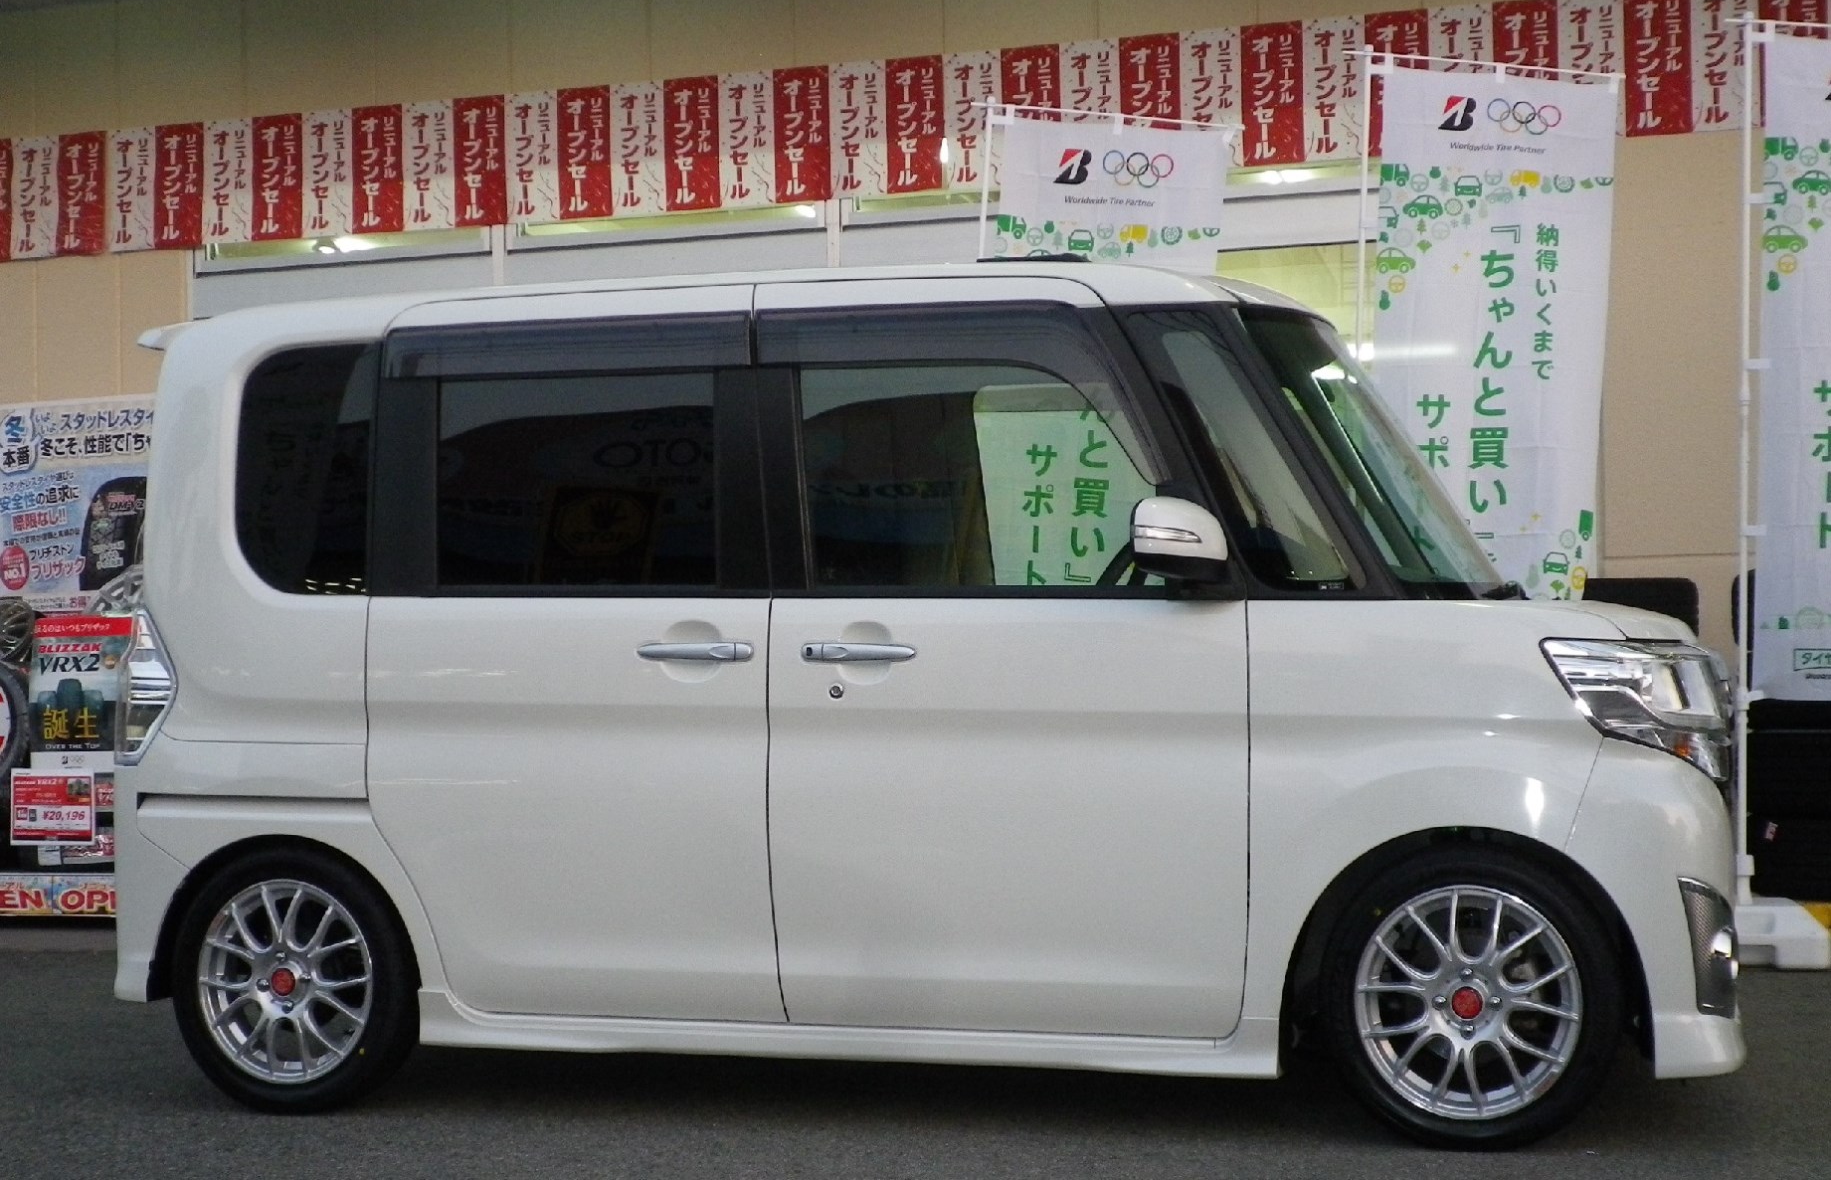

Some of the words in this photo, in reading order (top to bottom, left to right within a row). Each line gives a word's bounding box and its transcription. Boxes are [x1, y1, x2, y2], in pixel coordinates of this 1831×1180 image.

[1279, 34, 1294, 104] リニューアル
[1341, 29, 1357, 98] リニューアル
[1636, 1, 1662, 128] オープンセール
[1665, 0, 1682, 71] リニューアル
[864, 73, 878, 138] リニューアル
[921, 67, 936, 134] リニューアル
[1156, 45, 1172, 114] リニューアル
[1217, 40, 1232, 109] リニューアル
[1252, 36, 1276, 160] オープンセール
[1314, 30, 1338, 154] オープンセール
[434, 112, 447, 174] リニューアル
[485, 107, 498, 170] リニューアル
[537, 102, 550, 165] リニューアル
[590, 98, 604, 161] リニューアル
[643, 93, 657, 156] リニューアル
[697, 88, 711, 153] リニューアル
[728, 84, 750, 199] オープンセール
[753, 83, 766, 148] リニューアル
[783, 80, 805, 196] オープンセール
[808, 78, 822, 143] リニューアル
[839, 74, 861, 190] オープンセール
[896, 69, 918, 186] オープンセール
[954, 64, 977, 182] オープンセール
[39, 147, 52, 207] リニューアル
[84, 142, 99, 203] リニューアル
[136, 138, 149, 196] リニューアル
[185, 134, 197, 194] リニューアル
[234, 130, 246, 189] リニューアル
[260, 126, 281, 233] オープンセール
[282, 125, 296, 186] リニューアル
[311, 122, 329, 230] オープンセール
[333, 121, 346, 182] リニューアル
[361, 117, 381, 227] オープンセール
[383, 116, 396, 179] リニューアル
[412, 113, 431, 222] オープンセール
[463, 108, 484, 219] オープンセール
[515, 104, 535, 215] オープンセール
[567, 99, 588, 212] オープンセール
[620, 94, 641, 207] オープンセール
[674, 89, 696, 204] オープンセール
[1450, 141, 1493, 151] Worldwide
[1513, 145, 1546, 154] Partner
[20, 148, 37, 252] オープンセール
[64, 144, 85, 249] オープンセール
[116, 140, 133, 244] オープンセール
[162, 135, 182, 240] オープンセール
[211, 131, 229, 236] オープンセール
[1064, 195, 1107, 205] Worldwide
[1109, 197, 1124, 206] Tire
[1125, 198, 1155, 207] Partner
[1531, 222, 1559, 380] 納得いくまで
[2, 445, 30, 468] 本番
[31, 555, 86, 580] ブリザック
[38, 642, 103, 654] BLIZZAK
[39, 653, 101, 676] VRX2
[44, 707, 99, 740] 誕生
